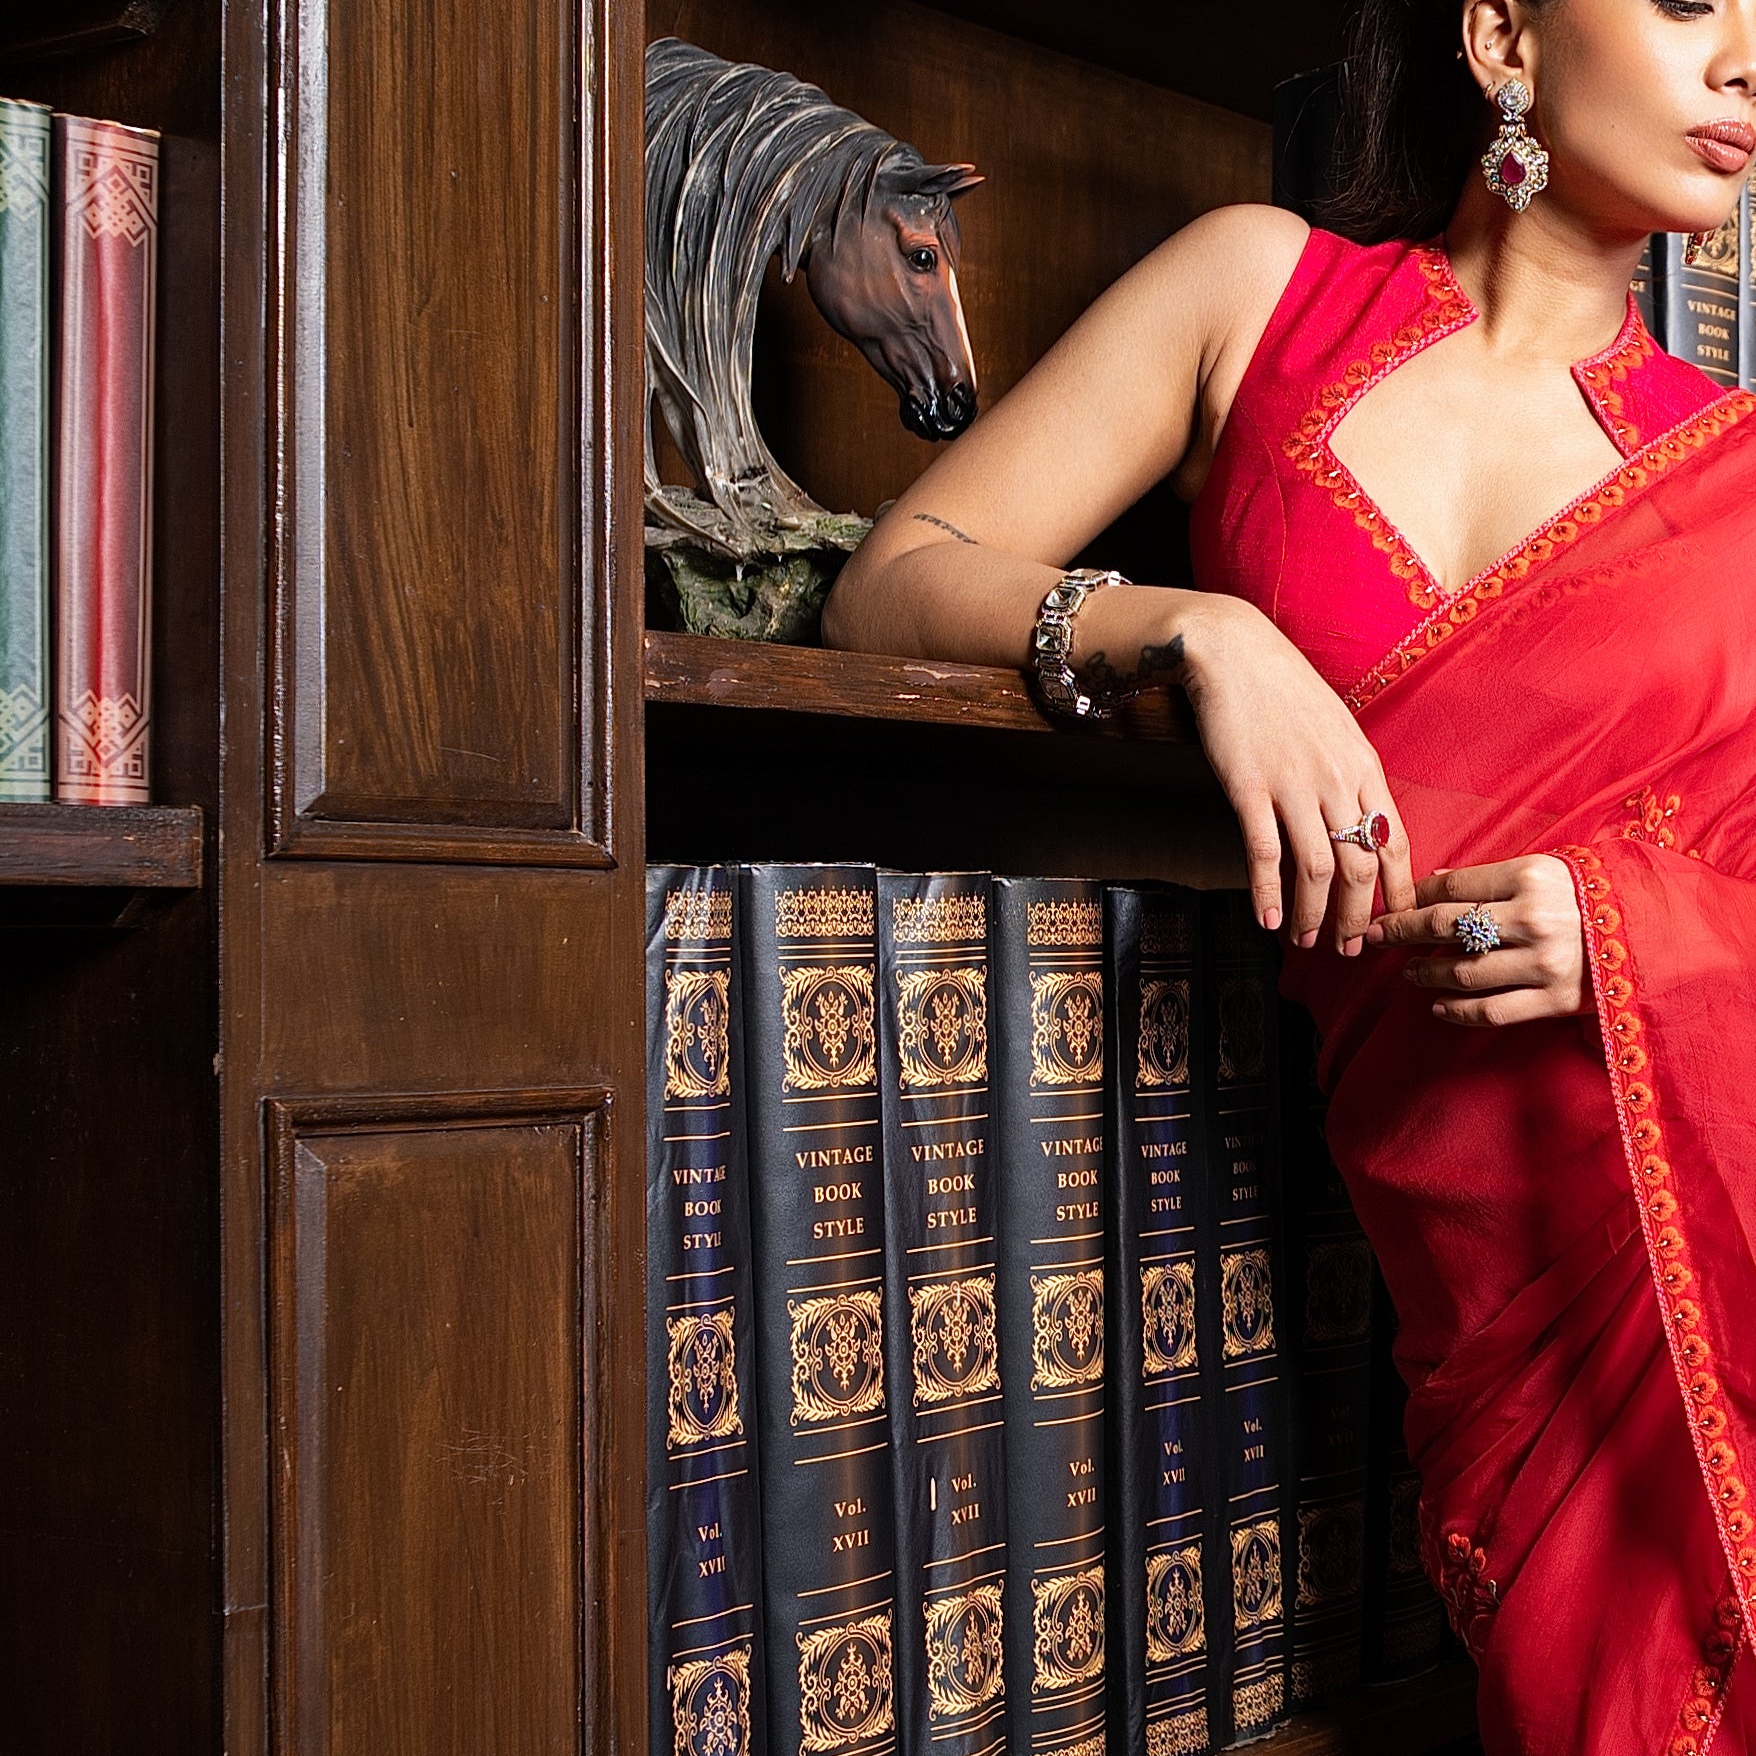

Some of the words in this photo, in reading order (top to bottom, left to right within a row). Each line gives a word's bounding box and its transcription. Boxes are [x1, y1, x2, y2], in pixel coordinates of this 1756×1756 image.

[1687, 299, 1737, 322] VINTAGE
[1698, 323, 1730, 340] BOOK
[1697, 345, 1731, 362] STYLE
[796, 1145, 874, 1169] VINTAGE
[911, 1139, 985, 1163] VINTAGE
[1141, 1141, 1188, 1159] VINTAGE
[927, 1173, 976, 1195] BOOK
[1057, 1169, 1098, 1189] BOOK
[1151, 1169, 1181, 1186] BOOK
[813, 1182, 863, 1203] BOOK
[1056, 1201, 1099, 1222] STYLE
[1151, 1196, 1182, 1213] STYLE
[813, 1217, 865, 1240] STYLE
[927, 1207, 977, 1229] STYLE
[1243, 1418, 1263, 1434] Vol.
[1163, 1439, 1184, 1456] Vol.
[1243, 1445, 1264, 1463] XVII
[1069, 1458, 1095, 1477] Vol.
[1162, 1467, 1186, 1486] XVII
[951, 1473, 977, 1493] Vol.
[834, 1497, 867, 1518] Vol.
[1067, 1487, 1096, 1508] XVII
[951, 1503, 980, 1525] XVII
[697, 1522, 723, 1543] Vol.
[832, 1529, 869, 1553] XVII
[698, 1555, 726, 1578] XVII
